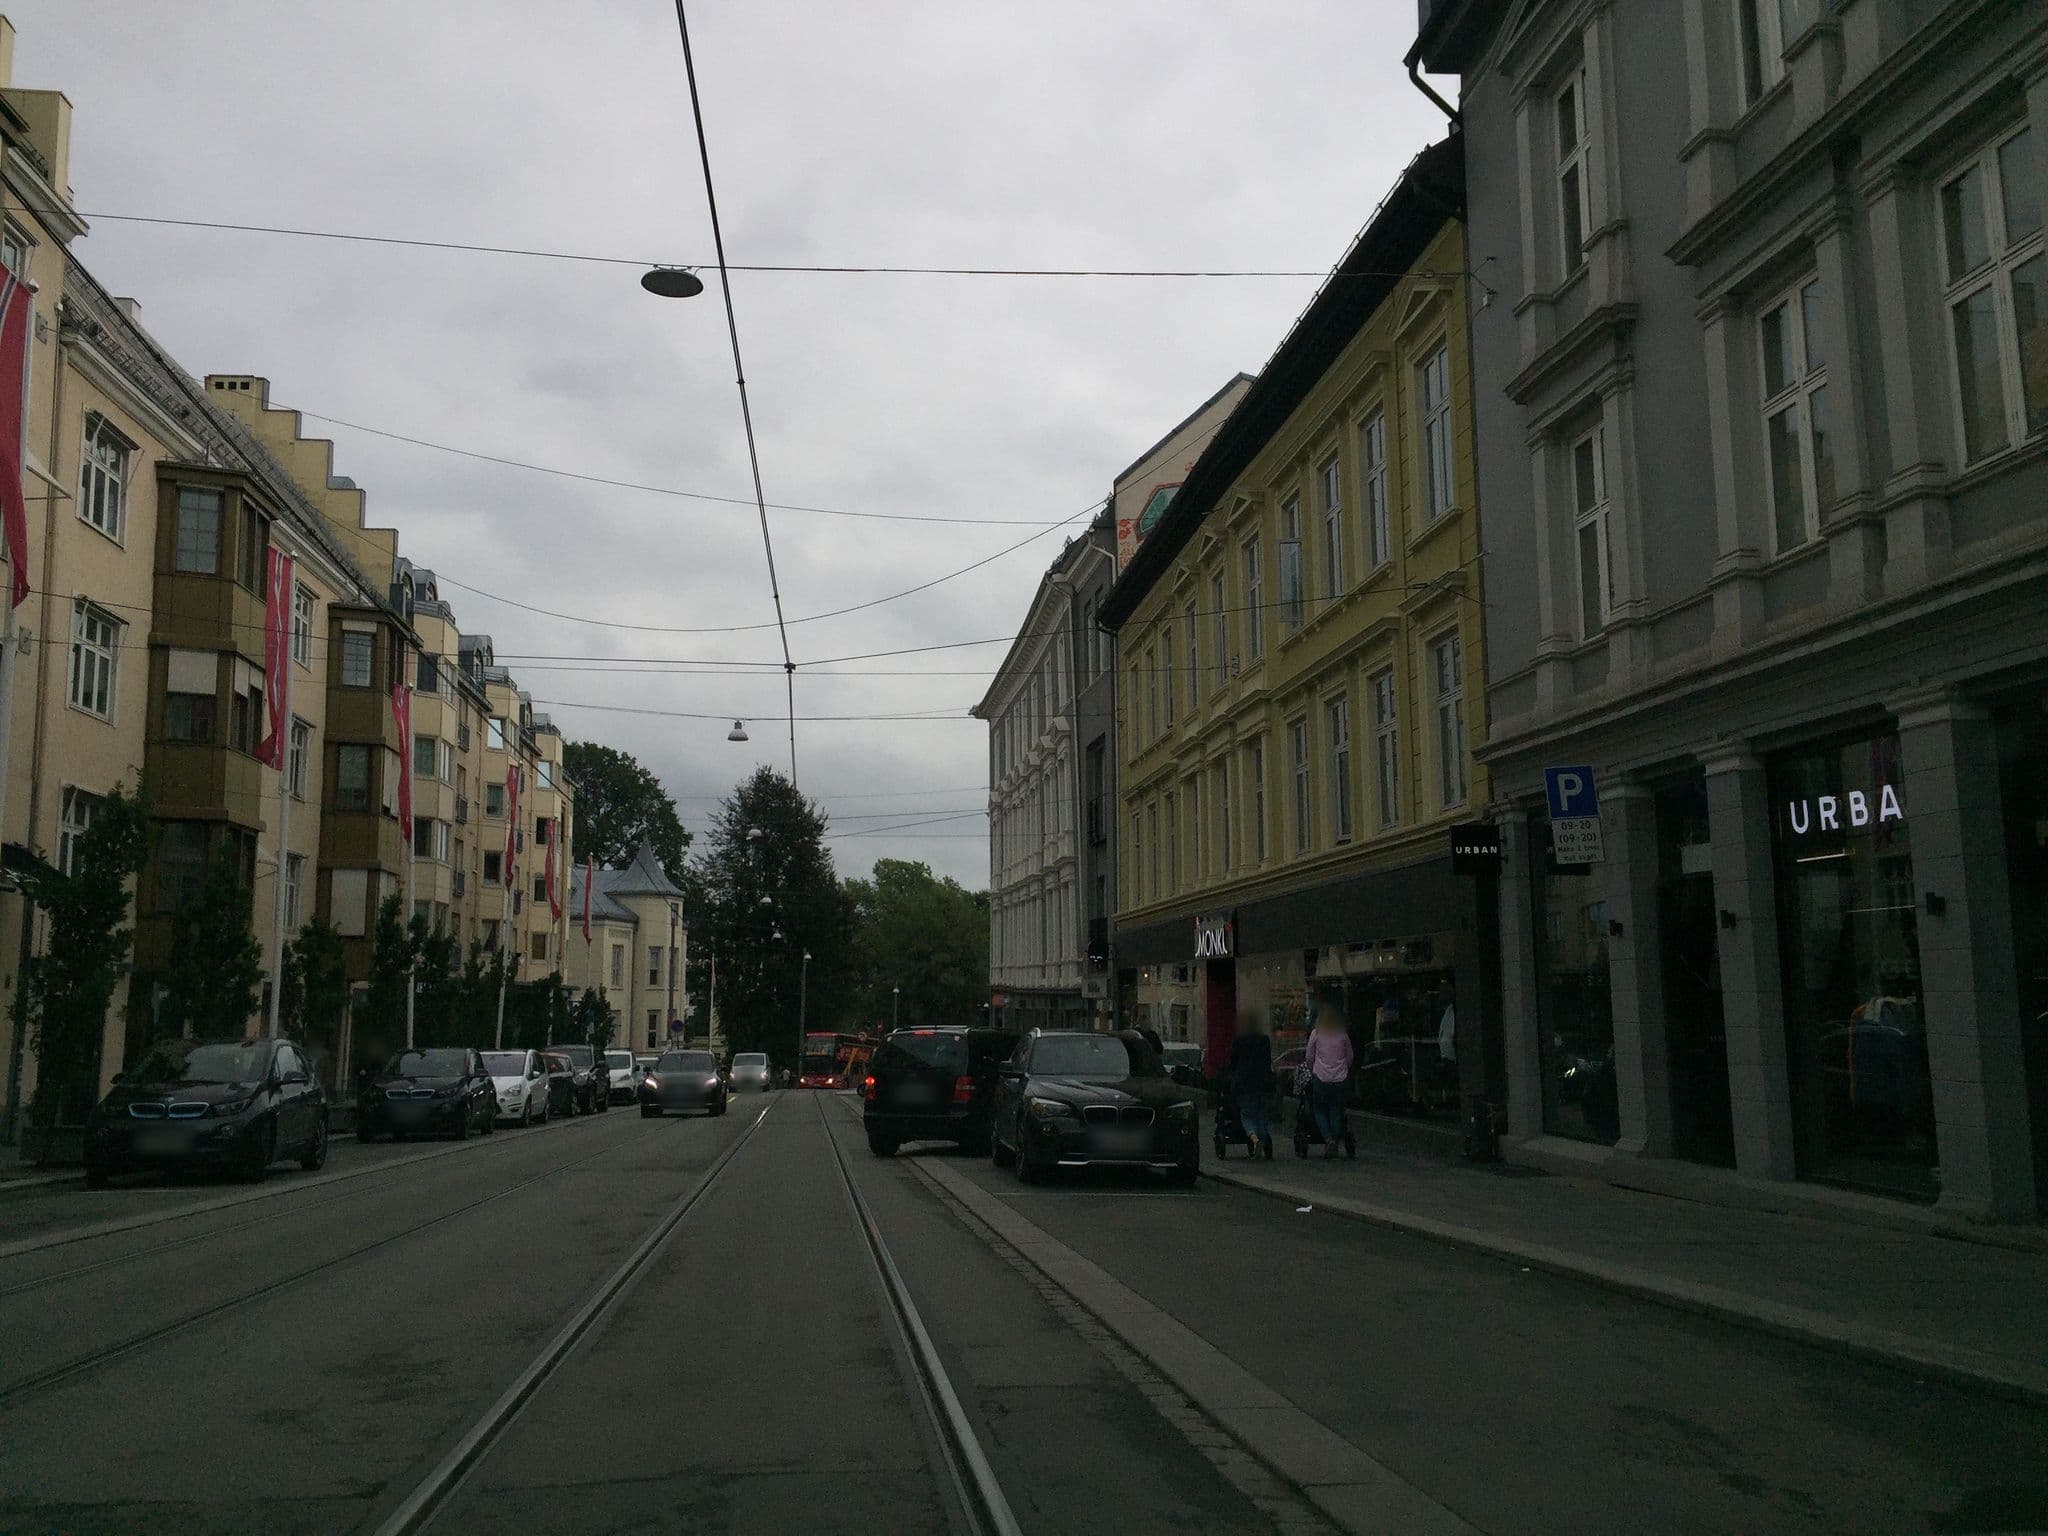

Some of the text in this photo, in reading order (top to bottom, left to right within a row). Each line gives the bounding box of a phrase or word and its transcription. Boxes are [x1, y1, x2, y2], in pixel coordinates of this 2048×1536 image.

[1557, 773, 1583, 811] P
[1790, 784, 1903, 834] URBA
[1455, 845, 1498, 854] URBAN
[1195, 927, 1228, 957] MONKI
